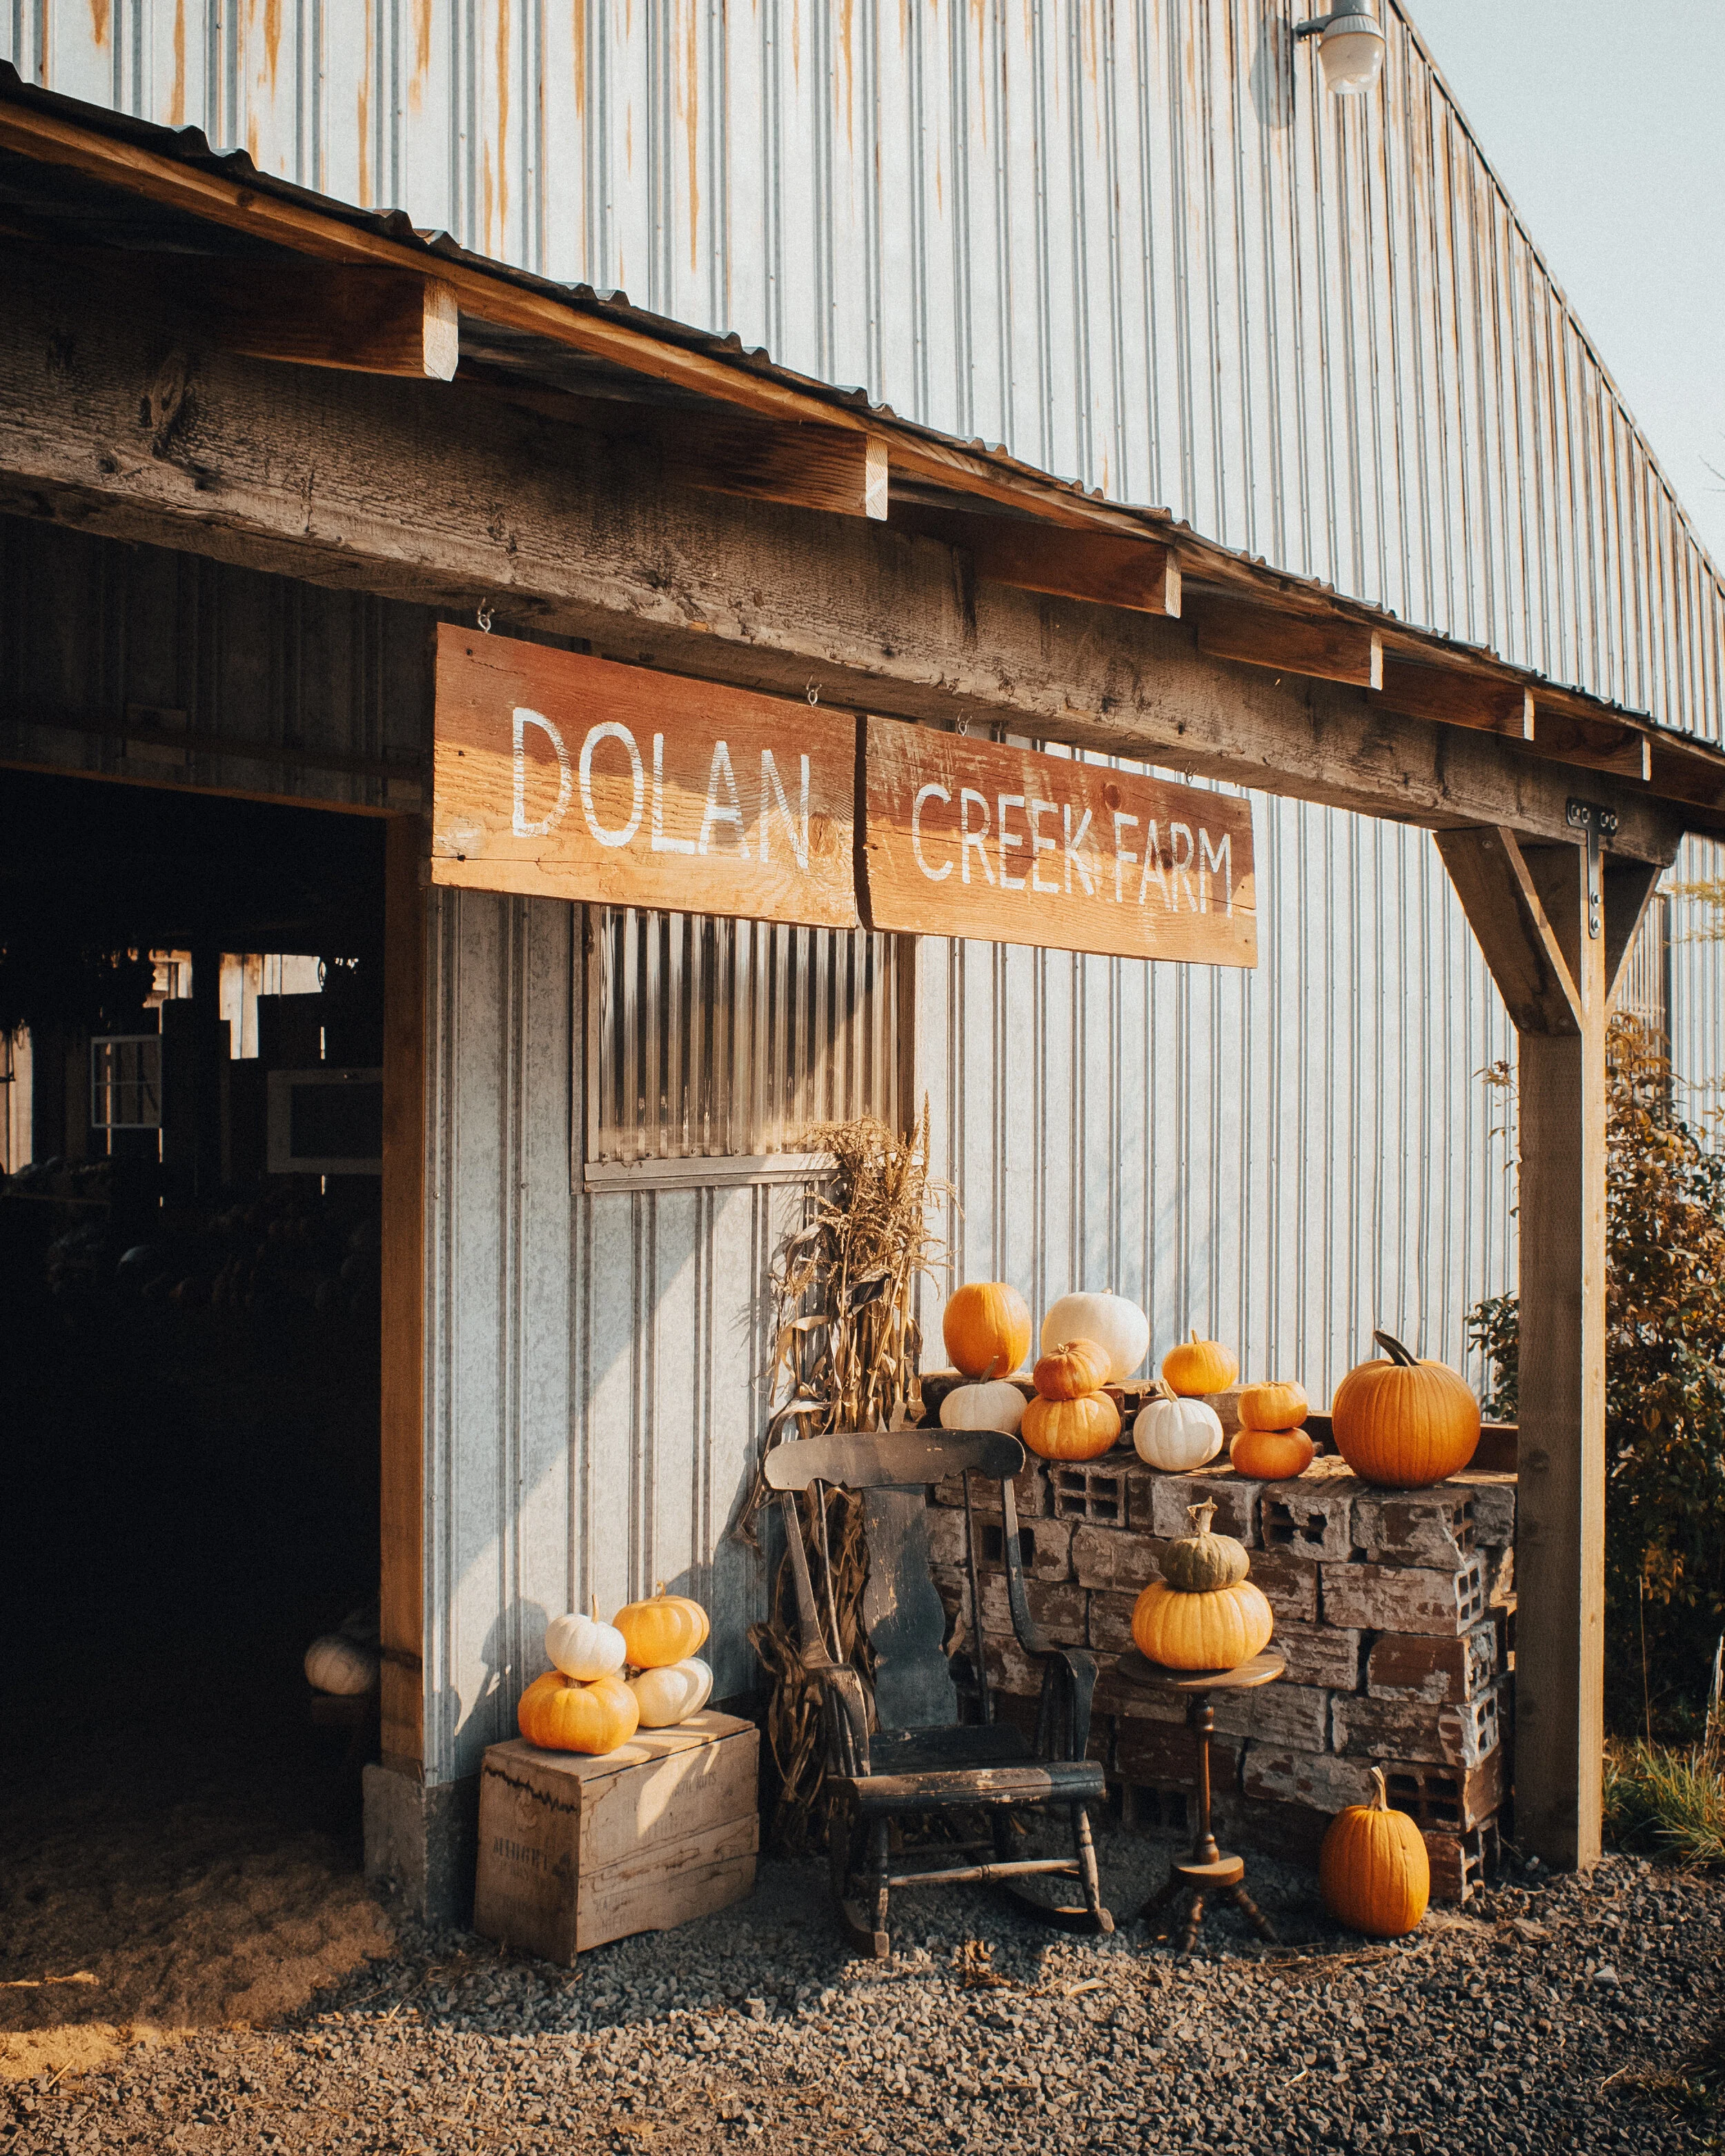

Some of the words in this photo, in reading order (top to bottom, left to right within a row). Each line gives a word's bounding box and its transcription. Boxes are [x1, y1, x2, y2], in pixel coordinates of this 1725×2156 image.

[511, 707, 811, 869] DOLAN
[910, 782, 1095, 896] CREEK
[1114, 811, 1234, 919] FARM
